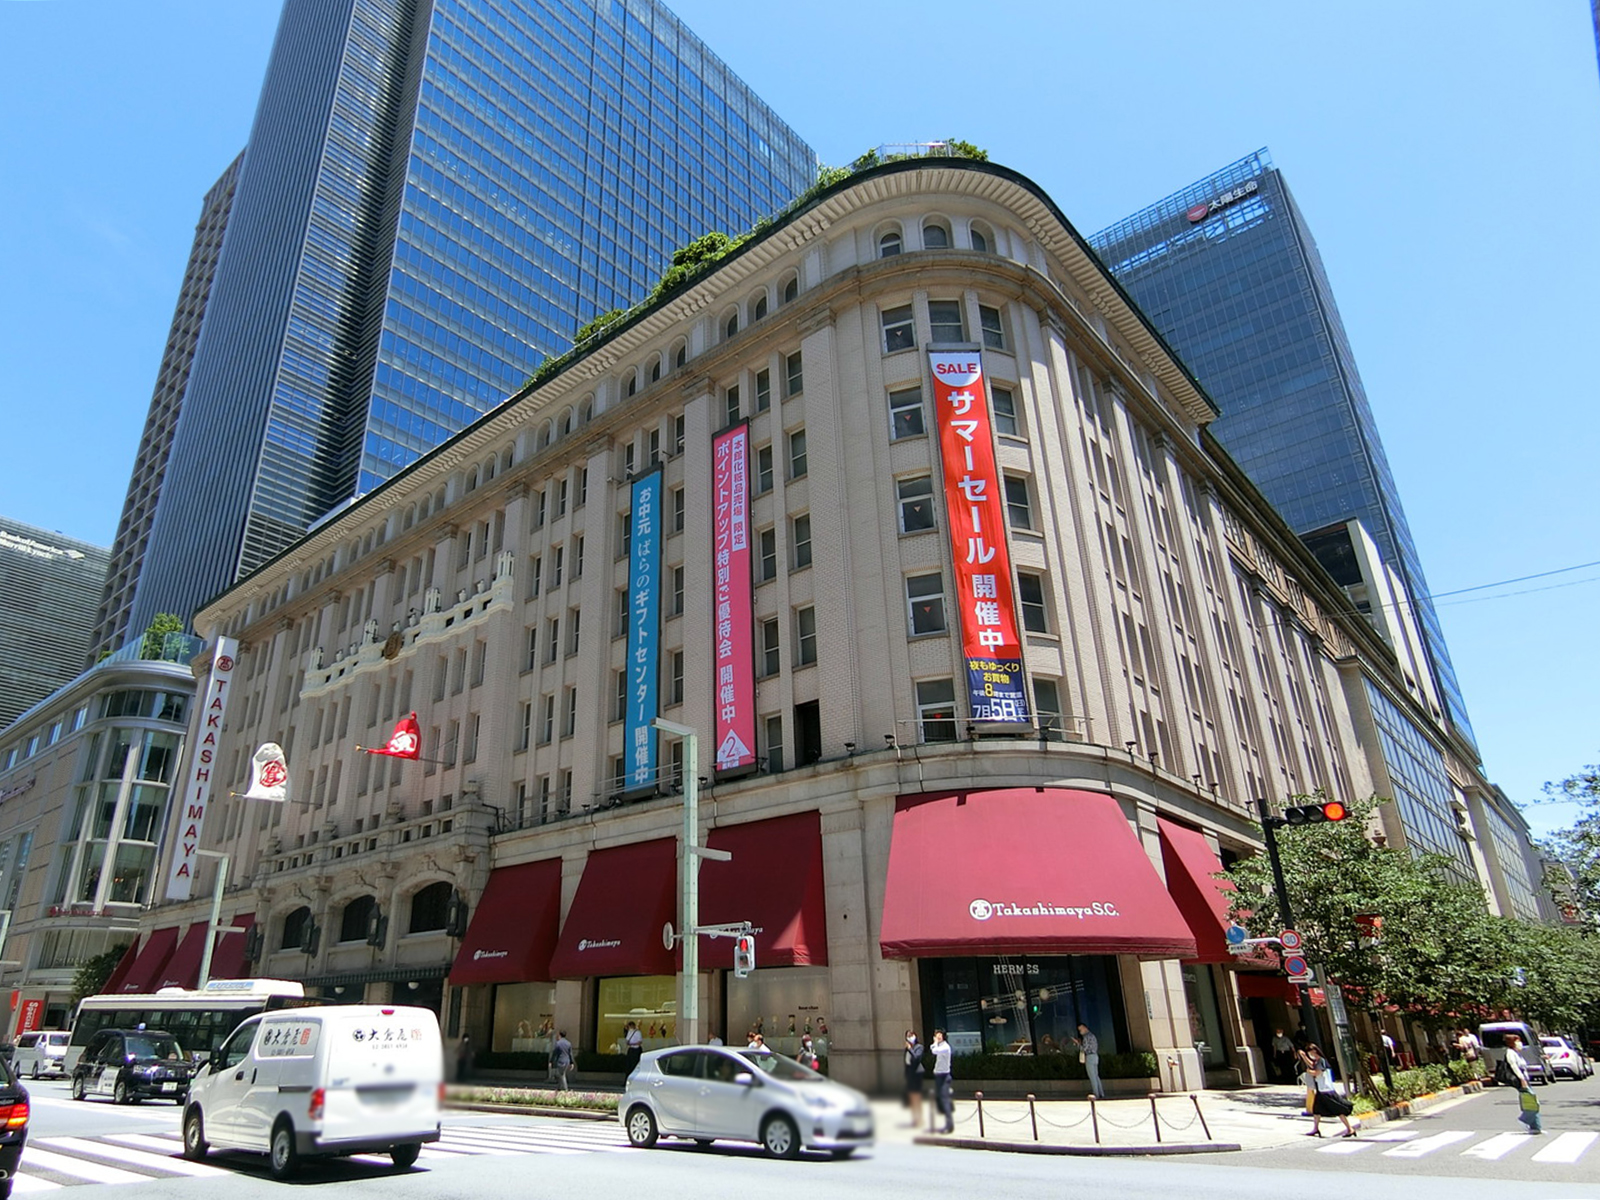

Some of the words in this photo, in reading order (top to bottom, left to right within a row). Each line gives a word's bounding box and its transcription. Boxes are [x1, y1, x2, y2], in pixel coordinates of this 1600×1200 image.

[1208, 181, 1258, 212] 太陽生命
[936, 363, 978, 375] SALE
[637, 486, 652, 537] お中元
[733, 520, 744, 546] 限定
[947, 390, 995, 565] サマーセール
[972, 574, 1004, 653] 開催中
[634, 538, 652, 722] ばらのギフトセンター
[720, 664, 736, 724] 開催中
[983, 672, 1010, 684] お買物
[176, 679, 228, 878] TAKASHIMAYA
[634, 724, 649, 785] 開催中
[1284, 934, 1297, 945] 30
